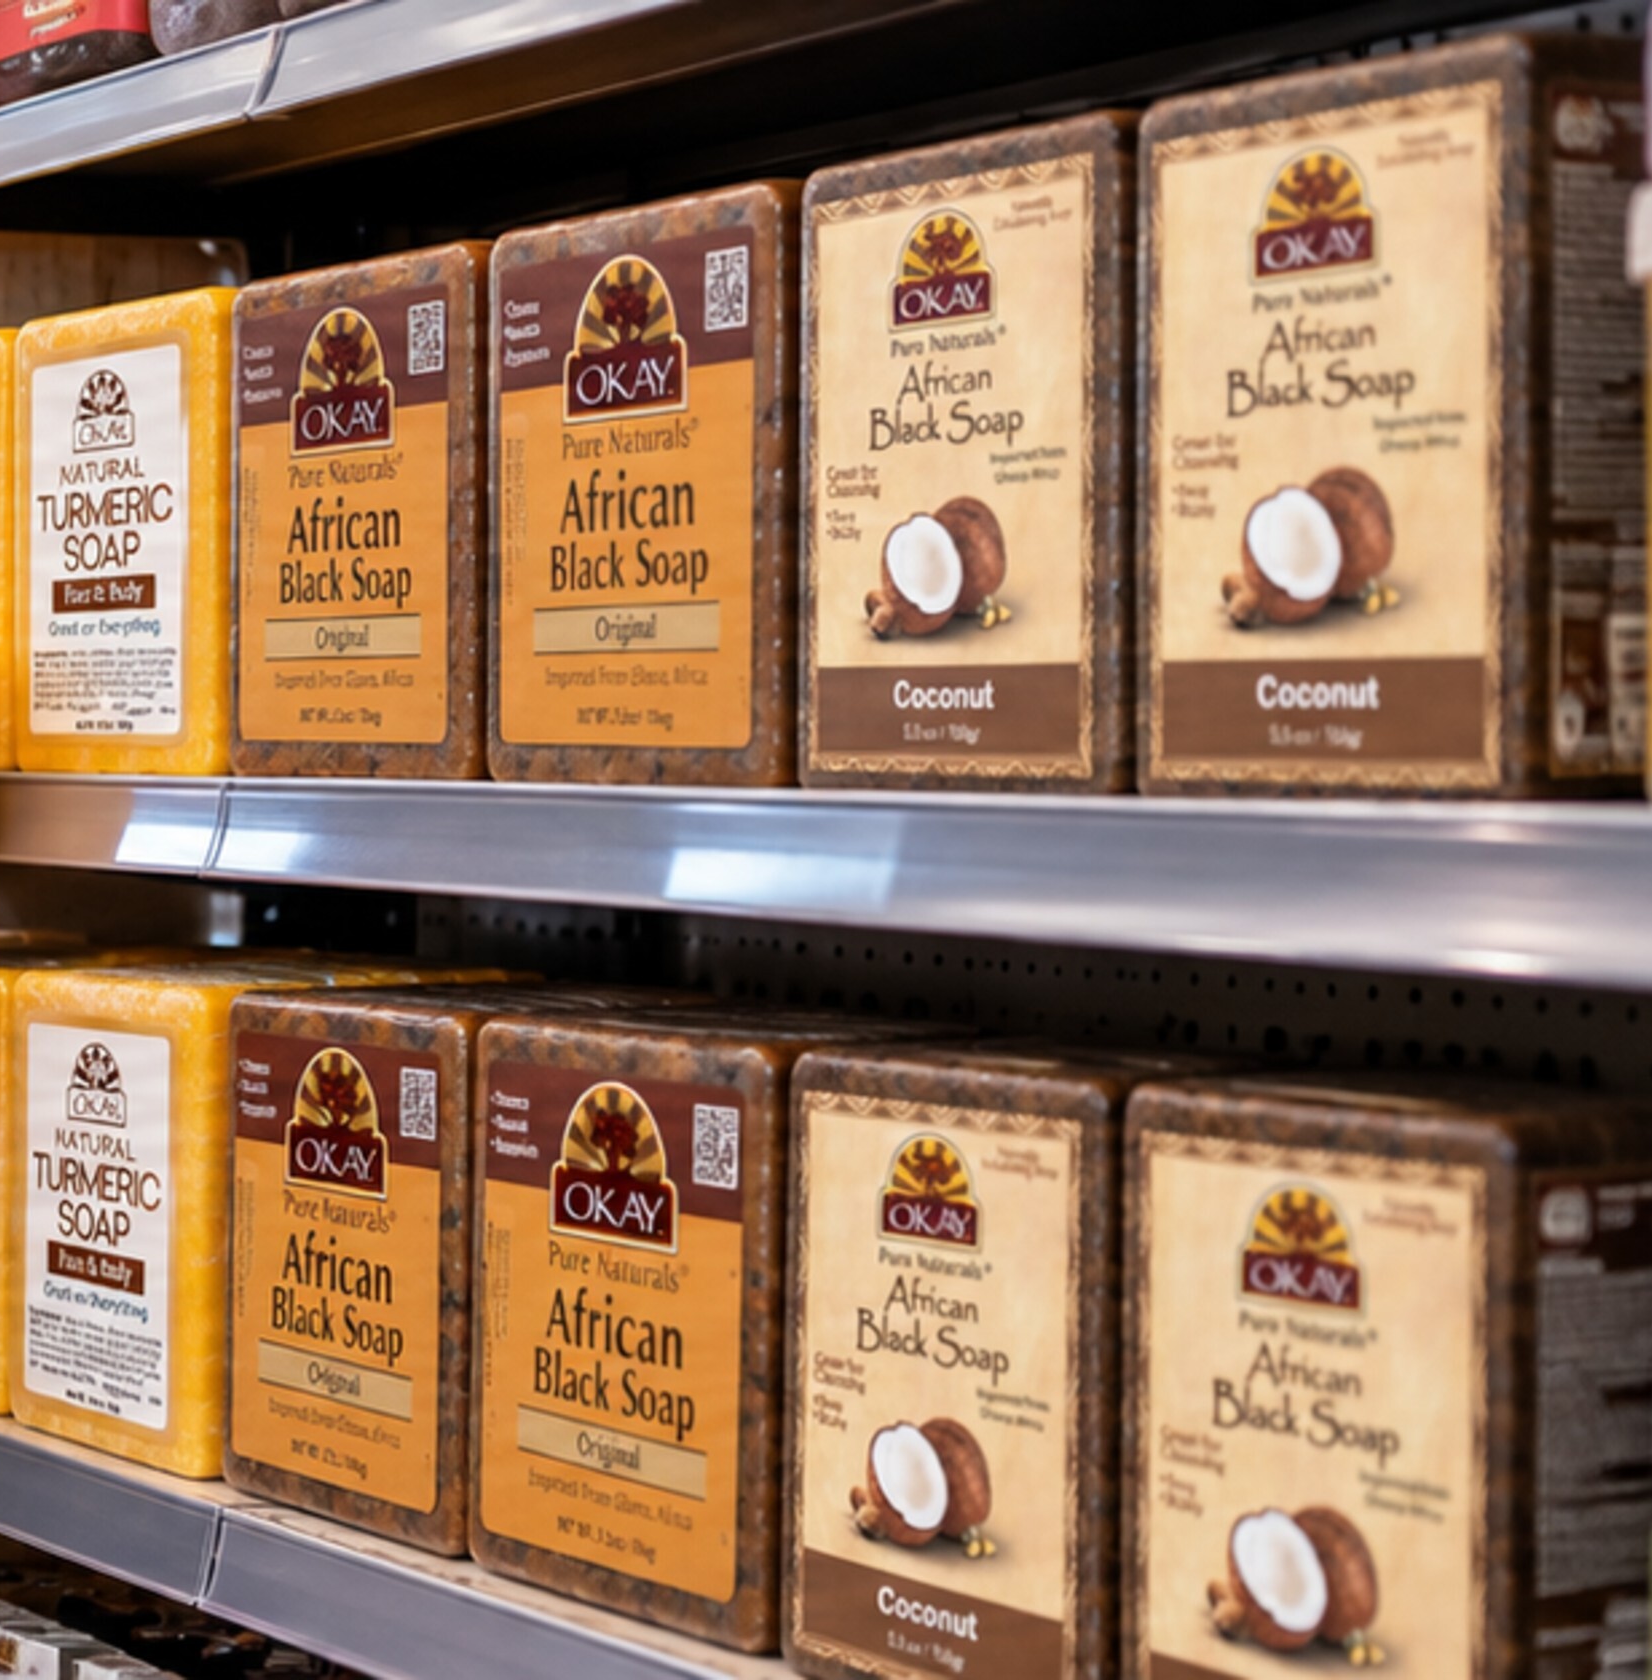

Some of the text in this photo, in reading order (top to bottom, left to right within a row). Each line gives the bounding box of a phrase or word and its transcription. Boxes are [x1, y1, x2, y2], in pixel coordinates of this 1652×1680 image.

[1262, 224, 1366, 270] OKAY
[899, 278, 984, 319] OKAY
[1262, 315, 1376, 363] African
[576, 356, 674, 405] OKAY
[897, 360, 992, 405] African
[1226, 359, 1416, 419] Black Soap
[301, 398, 383, 440] OKAY
[869, 400, 1025, 451] Black Soap
[59, 457, 145, 487] NATURAL
[37, 483, 173, 532] TURMERIC
[288, 496, 401, 554] African
[560, 468, 695, 534] African
[64, 530, 140, 572] SOAP
[551, 538, 709, 595] Black Soap
[280, 556, 412, 609] Black Soap
[595, 612, 656, 647] Original
[894, 679, 994, 710] Coconut
[1255, 674, 1380, 710] Coconut
[55, 1127, 138, 1162] NATURAL
[296, 1137, 377, 1181] OKAY
[33, 1151, 162, 1212] TURMERIC
[58, 1200, 131, 1248] SOAP
[564, 1182, 663, 1233] OKAY
[889, 1203, 972, 1239] OKAY
[282, 1229, 393, 1305] African
[1248, 1257, 1353, 1304] OKAY
[884, 1275, 979, 1323] African
[272, 1286, 404, 1367] Black Soap
[547, 1287, 682, 1370] African
[857, 1307, 928, 1358] Black
[933, 1325, 1010, 1388] Soap
[534, 1346, 695, 1442] Black Soap
[1247, 1341, 1362, 1398] African
[1212, 1376, 1401, 1471] Black Soap
[876, 1585, 979, 1641] Coconut
